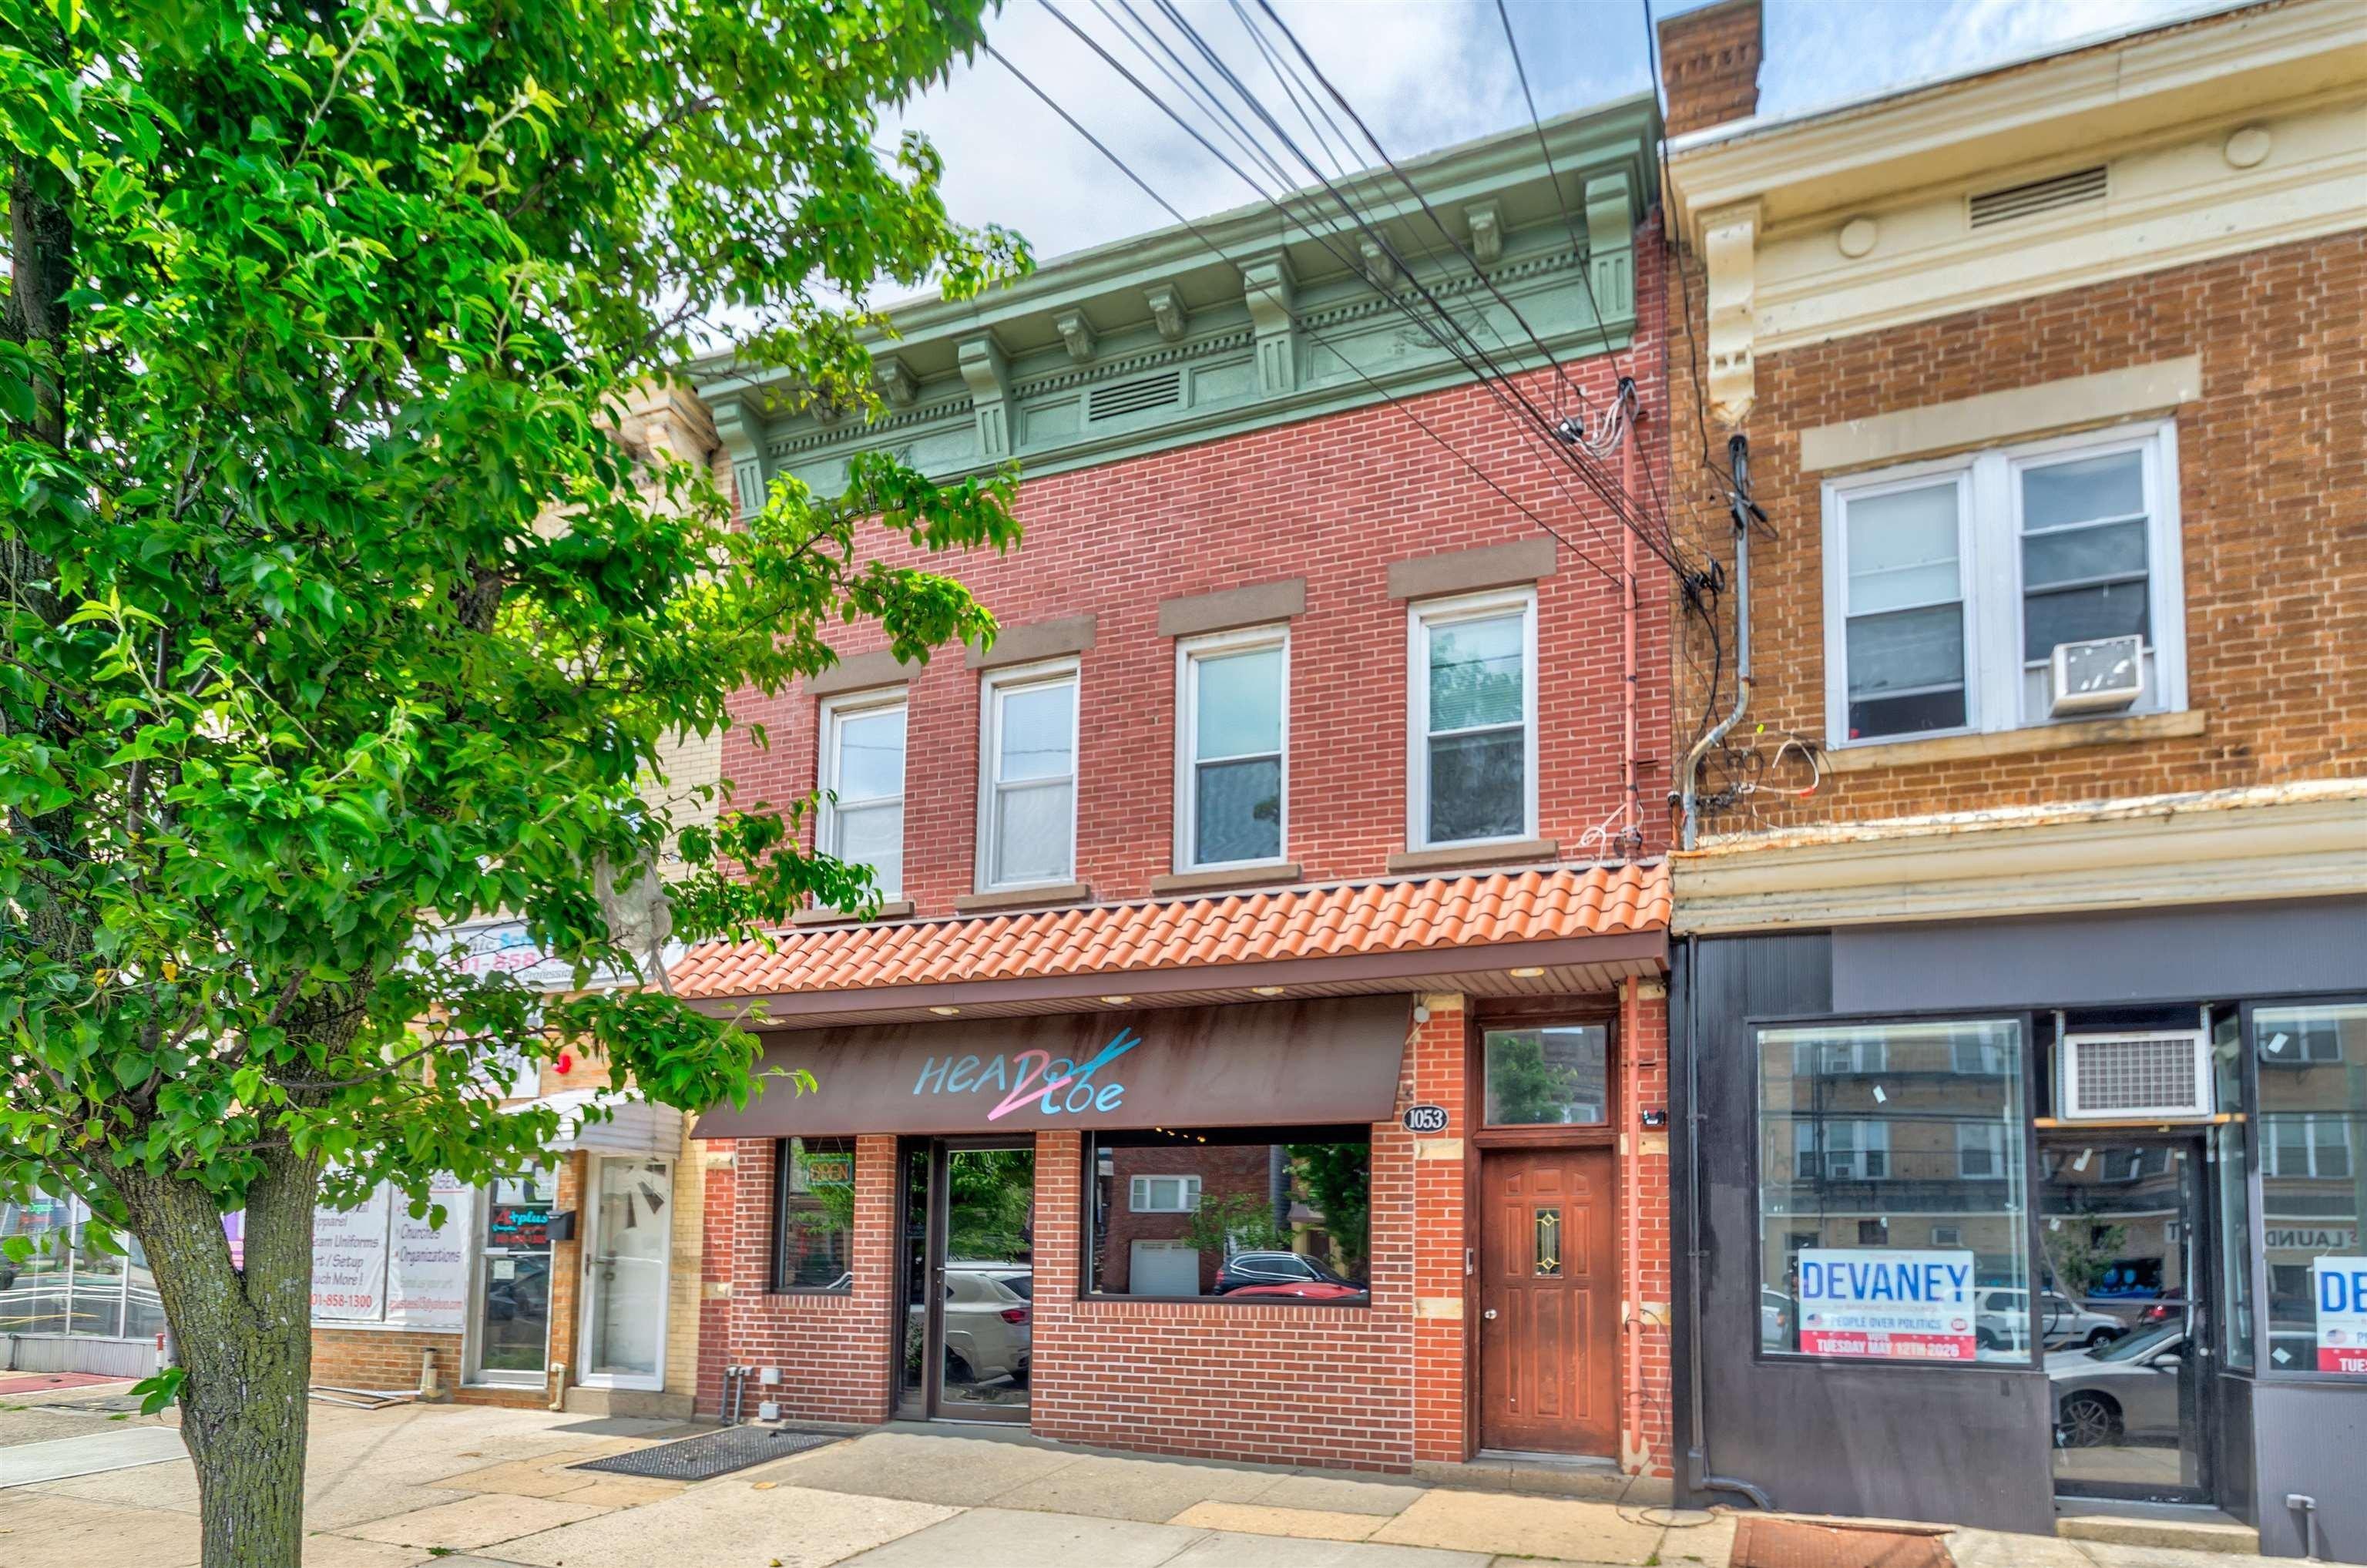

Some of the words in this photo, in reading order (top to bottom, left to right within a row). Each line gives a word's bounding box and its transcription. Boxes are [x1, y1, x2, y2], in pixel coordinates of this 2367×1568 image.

[1408, 1109, 1443, 1129] 1053
[810, 1163, 848, 1181] OPEN
[312, 1237, 333, 1247] eam
[334, 1234, 379, 1248] Uniforms
[314, 1254, 325, 1267] rt
[333, 1254, 364, 1272] Setup
[400, 1245, 462, 1266] Organizations
[313, 1272, 331, 1284] uch
[1803, 1261, 1969, 1302] DEVANEY
[311, 1294, 373, 1308] 01-858-1300
[1831, 1315, 1865, 1328] PEOPLE
[1869, 1316, 1895, 1329] OVER
[1897, 1318, 1943, 1331] POLITICS
[1816, 1338, 1866, 1354] TUESDAY
[1868, 1340, 1893, 1355] MAY
[1895, 1341, 1926, 1357] 12TH
